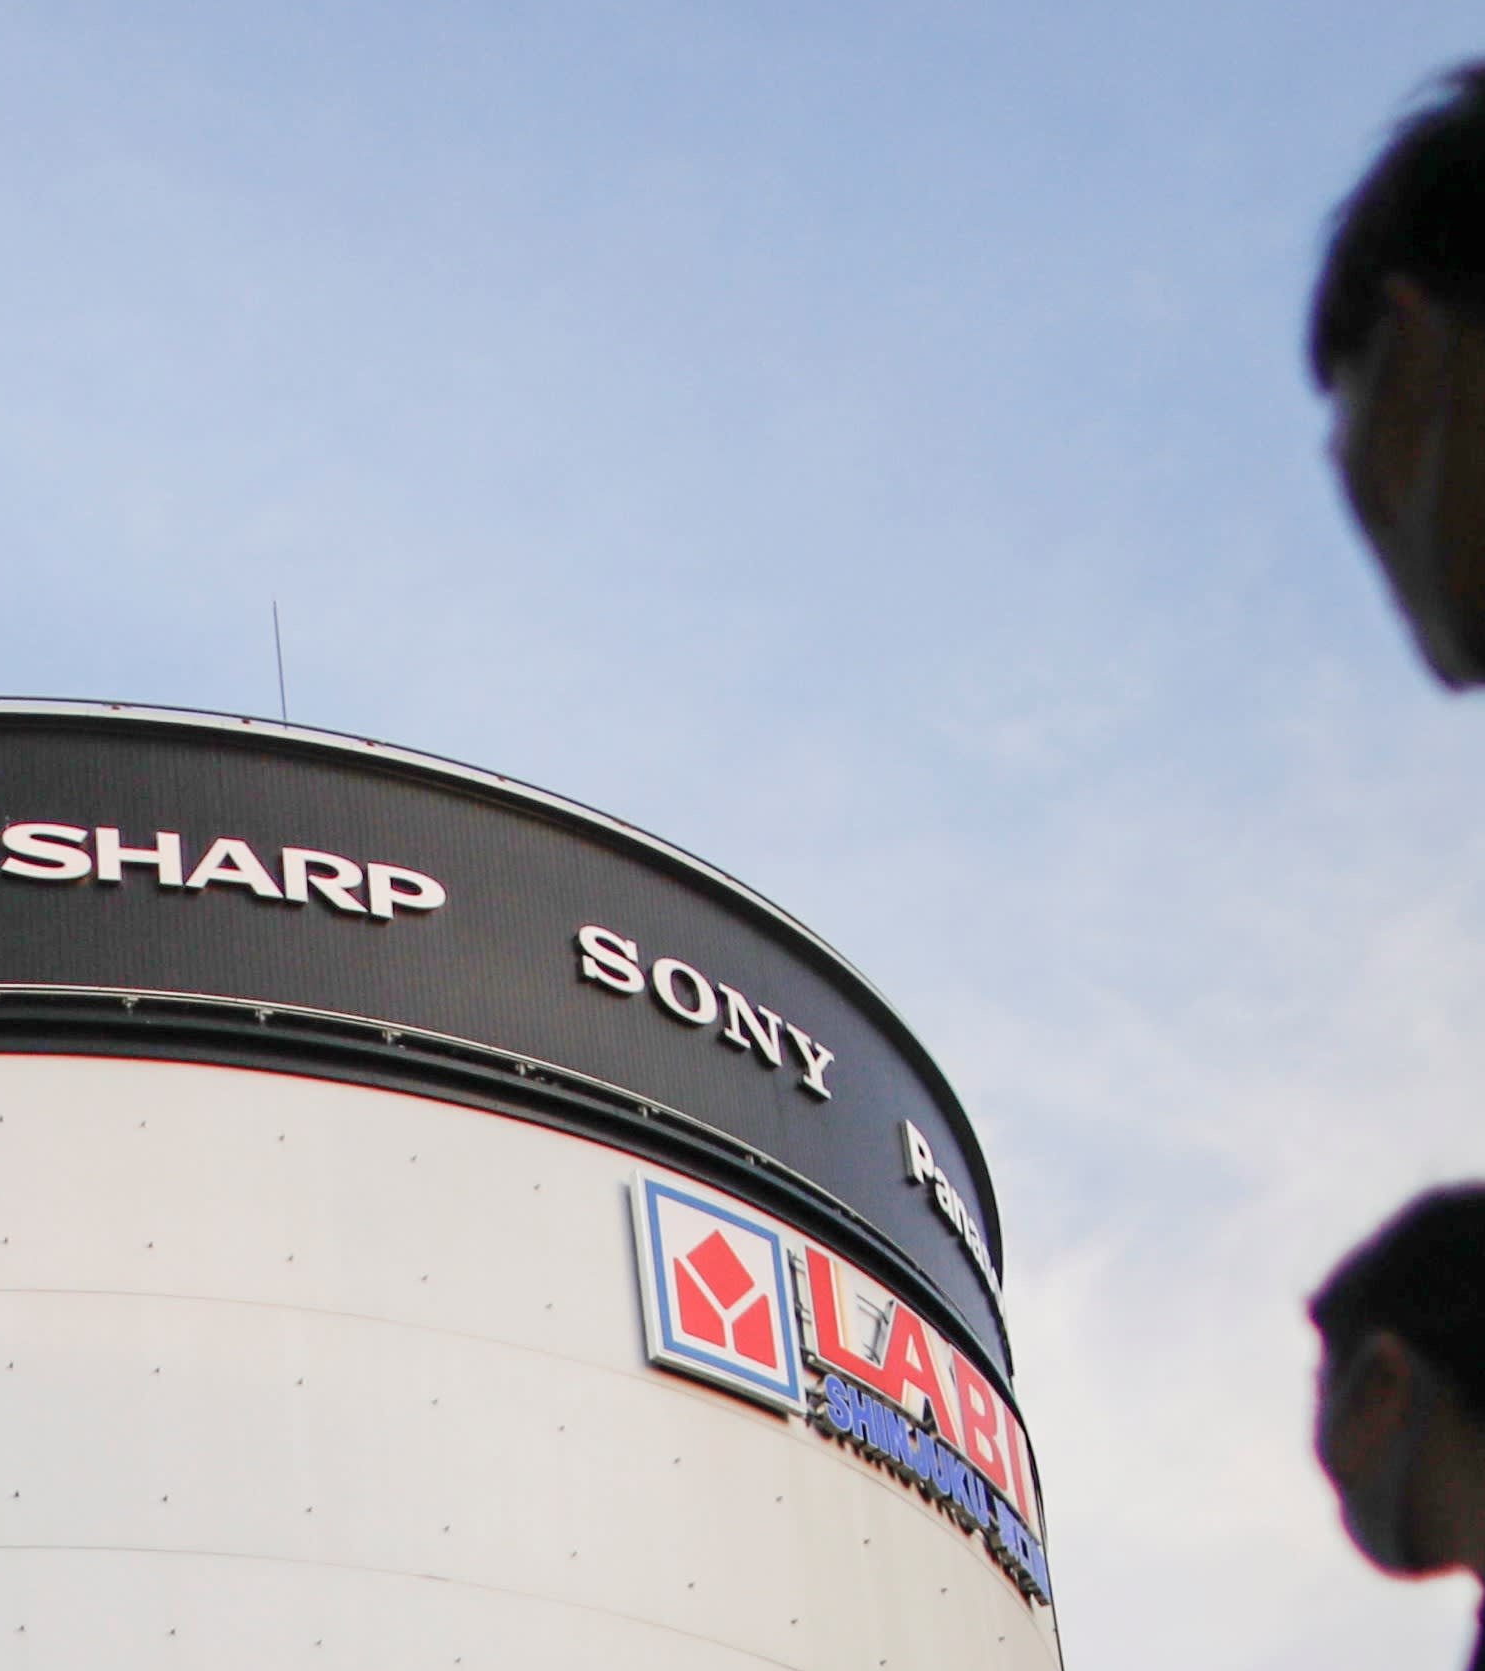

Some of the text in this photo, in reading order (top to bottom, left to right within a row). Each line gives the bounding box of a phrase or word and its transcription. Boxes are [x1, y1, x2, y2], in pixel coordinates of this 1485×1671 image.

[0, 822, 448, 920] SHARP
[577, 924, 835, 1101] SONY
[902, 1119, 1006, 1318] Panas
[804, 1244, 1032, 1520] LABI
[825, 1373, 990, 1528] SHINJUKU
